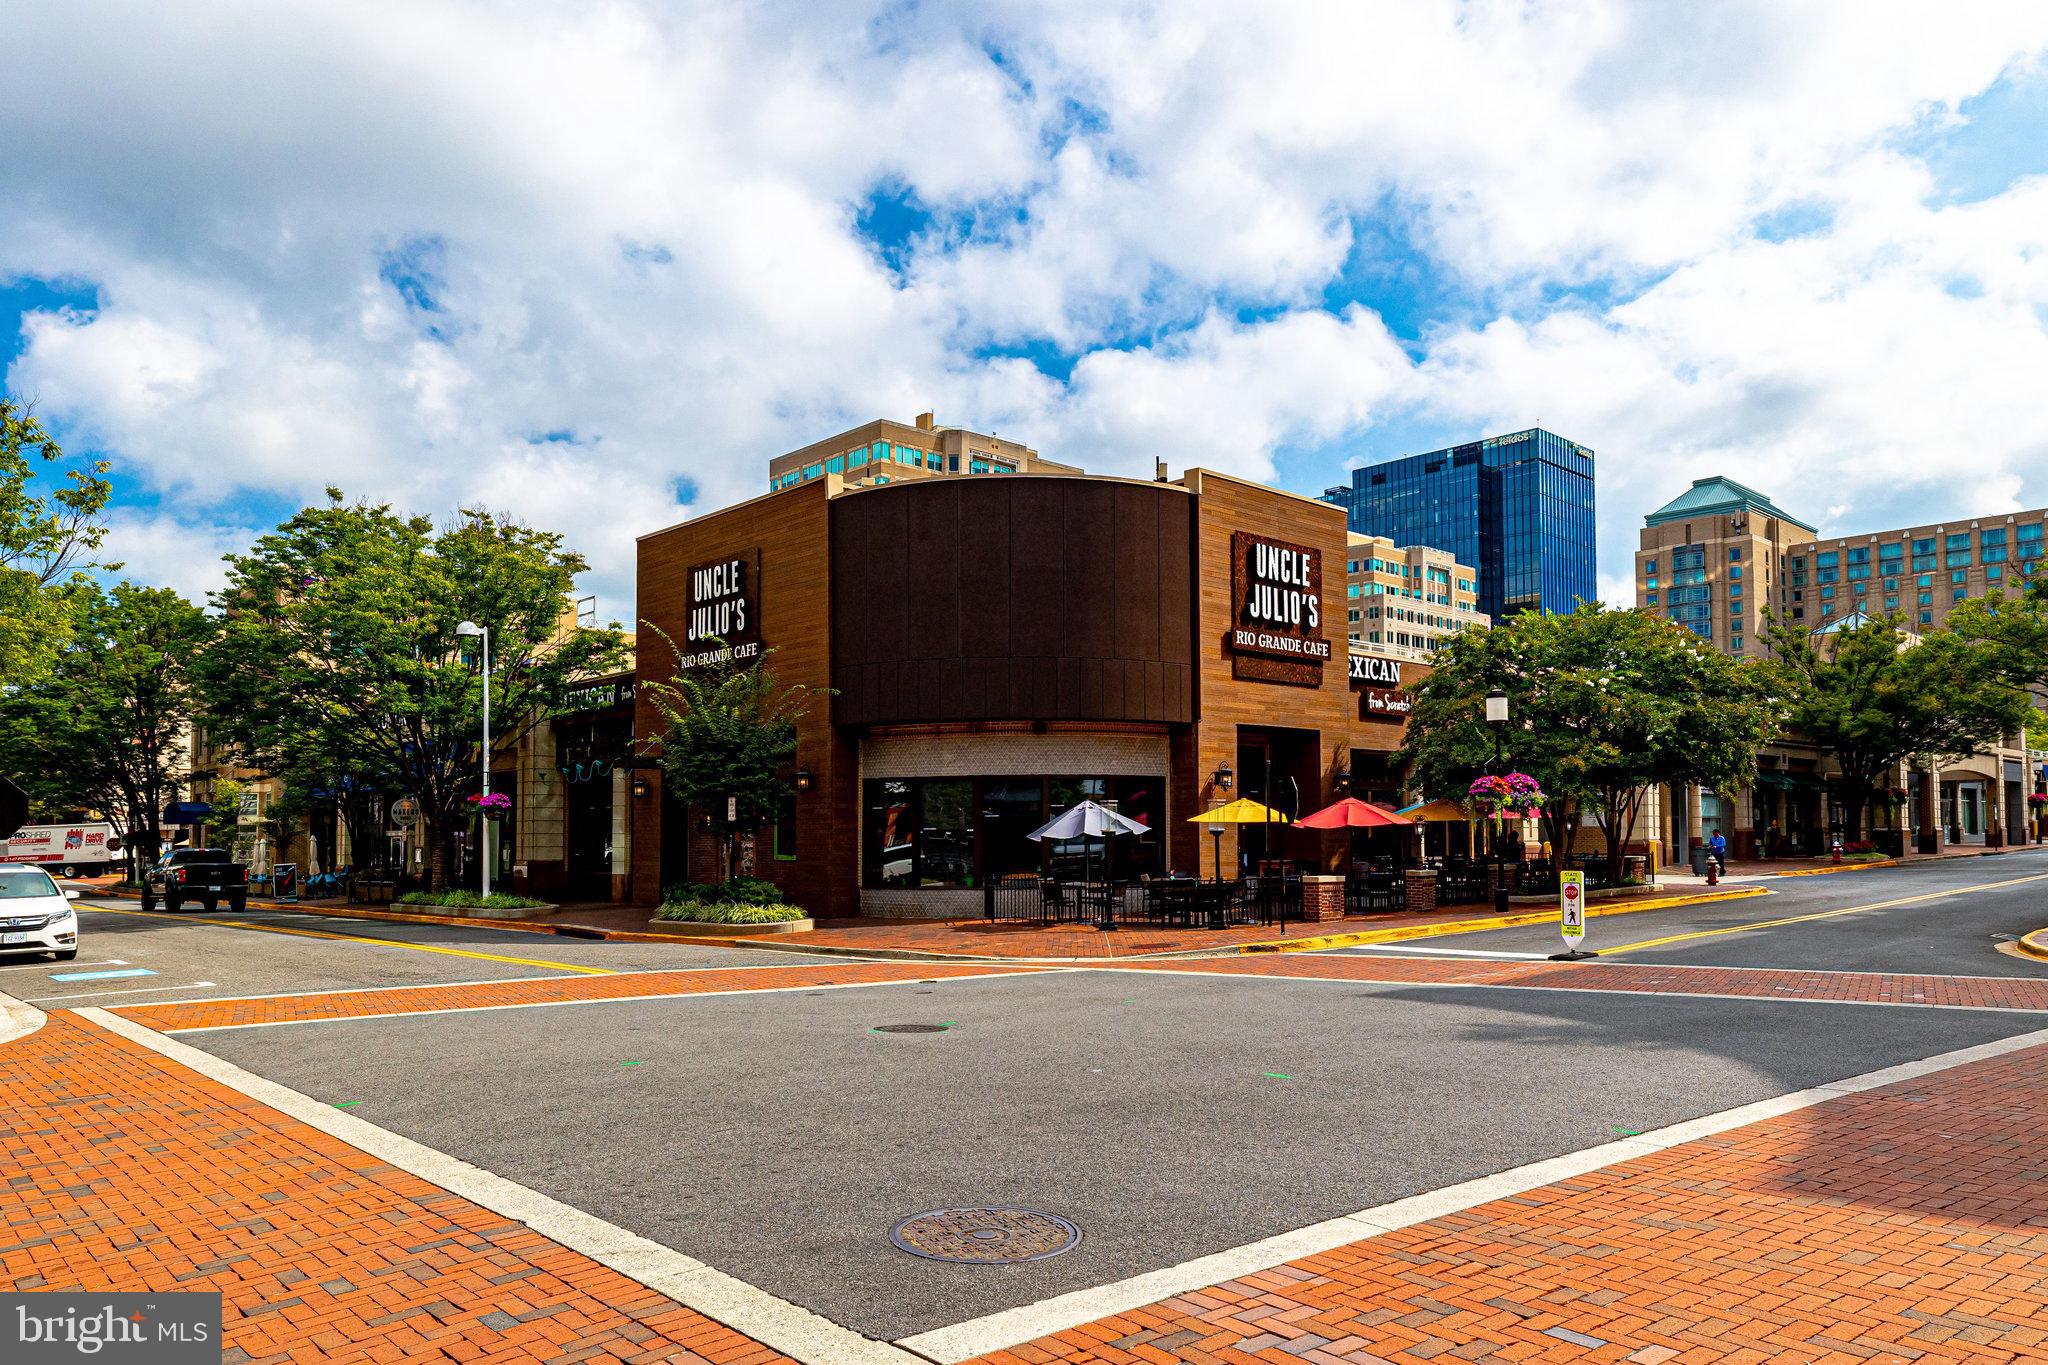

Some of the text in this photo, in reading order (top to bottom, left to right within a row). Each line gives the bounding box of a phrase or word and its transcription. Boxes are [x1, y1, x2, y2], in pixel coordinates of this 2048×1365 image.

[1499, 432, 1529, 446] leidos
[694, 560, 739, 602] UNCLE
[1256, 543, 1310, 587] UNCLE
[688, 598, 745, 641] JULIO'S
[1249, 584, 1318, 628] JULIO'S
[681, 642, 758, 669] RIO GRANDE CAFE
[1236, 630, 1329, 656] RIO GRANDE CAFE
[1369, 692, 1384, 709] from
